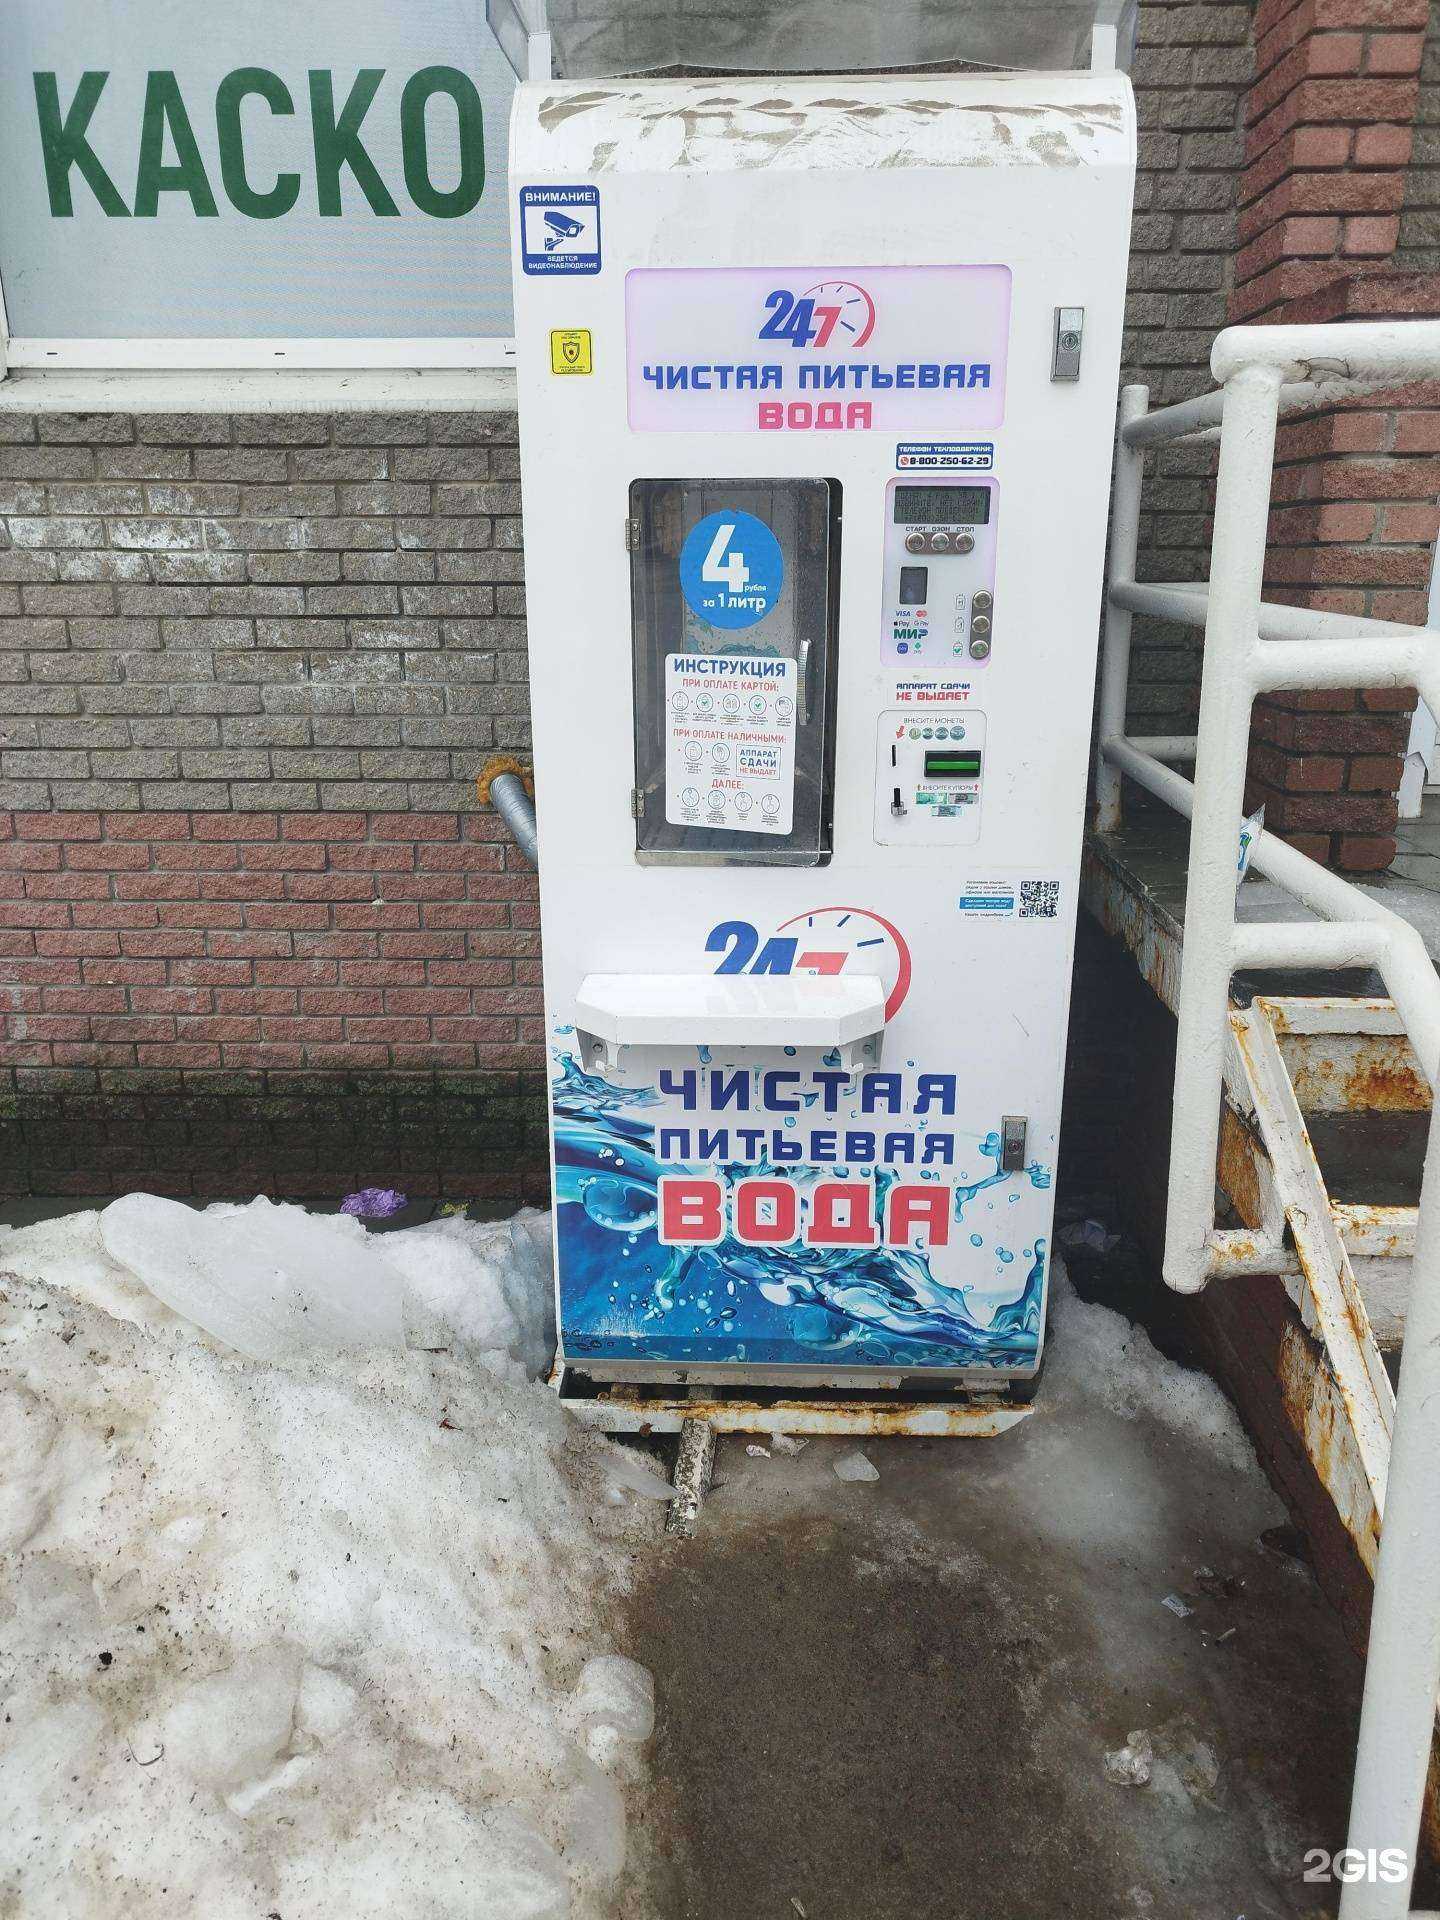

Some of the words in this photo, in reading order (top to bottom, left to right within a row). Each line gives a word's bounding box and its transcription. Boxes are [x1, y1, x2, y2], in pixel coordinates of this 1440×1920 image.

[32, 66, 486, 219] КАСКО
[525, 192, 596, 203] ВНИМАНИЕ!
[528, 261, 598, 269] ВИДЕОНАБЛЮДЕНИЕ
[643, 365, 783, 390] ЧИСТАЯ
[798, 364, 991, 389] ПИТЬЕВАЯ
[758, 402, 873, 430] ВОДА
[909, 457, 989, 465] 8-800-250-62-29
[702, 525, 750, 592] 4
[702, 600, 715, 608] за
[717, 593, 725, 608] 1
[727, 596, 767, 612] литр
[893, 628, 928, 639] МИР
[674, 658, 786, 678] ИНСТРУКЦИЯ
[682, 678, 701, 688] ПРИ
[703, 680, 738, 690] ОПЛАТЕ
[741, 681, 779, 692] КАРТОЙ:
[896, 692, 912, 700] НЕ
[917, 692, 970, 700] ВЫДАЕТ
[673, 729, 690, 738] ПРИ
[692, 730, 726, 740] ОПЛАТЕ
[728, 732, 787, 743] НАЛИЧНЫМИ:
[740, 749, 778, 758] АППАРАТ
[740, 757, 777, 768] СДАЧИ
[739, 767, 750, 775] НЕ
[711, 778, 744, 790] ДАЛЕЕ:
[659, 1069, 957, 1116] ЧИСТАЯ
[660, 1128, 955, 1165] ПИТЬЕВАЯ
[661, 1180, 951, 1246] ВОДА
